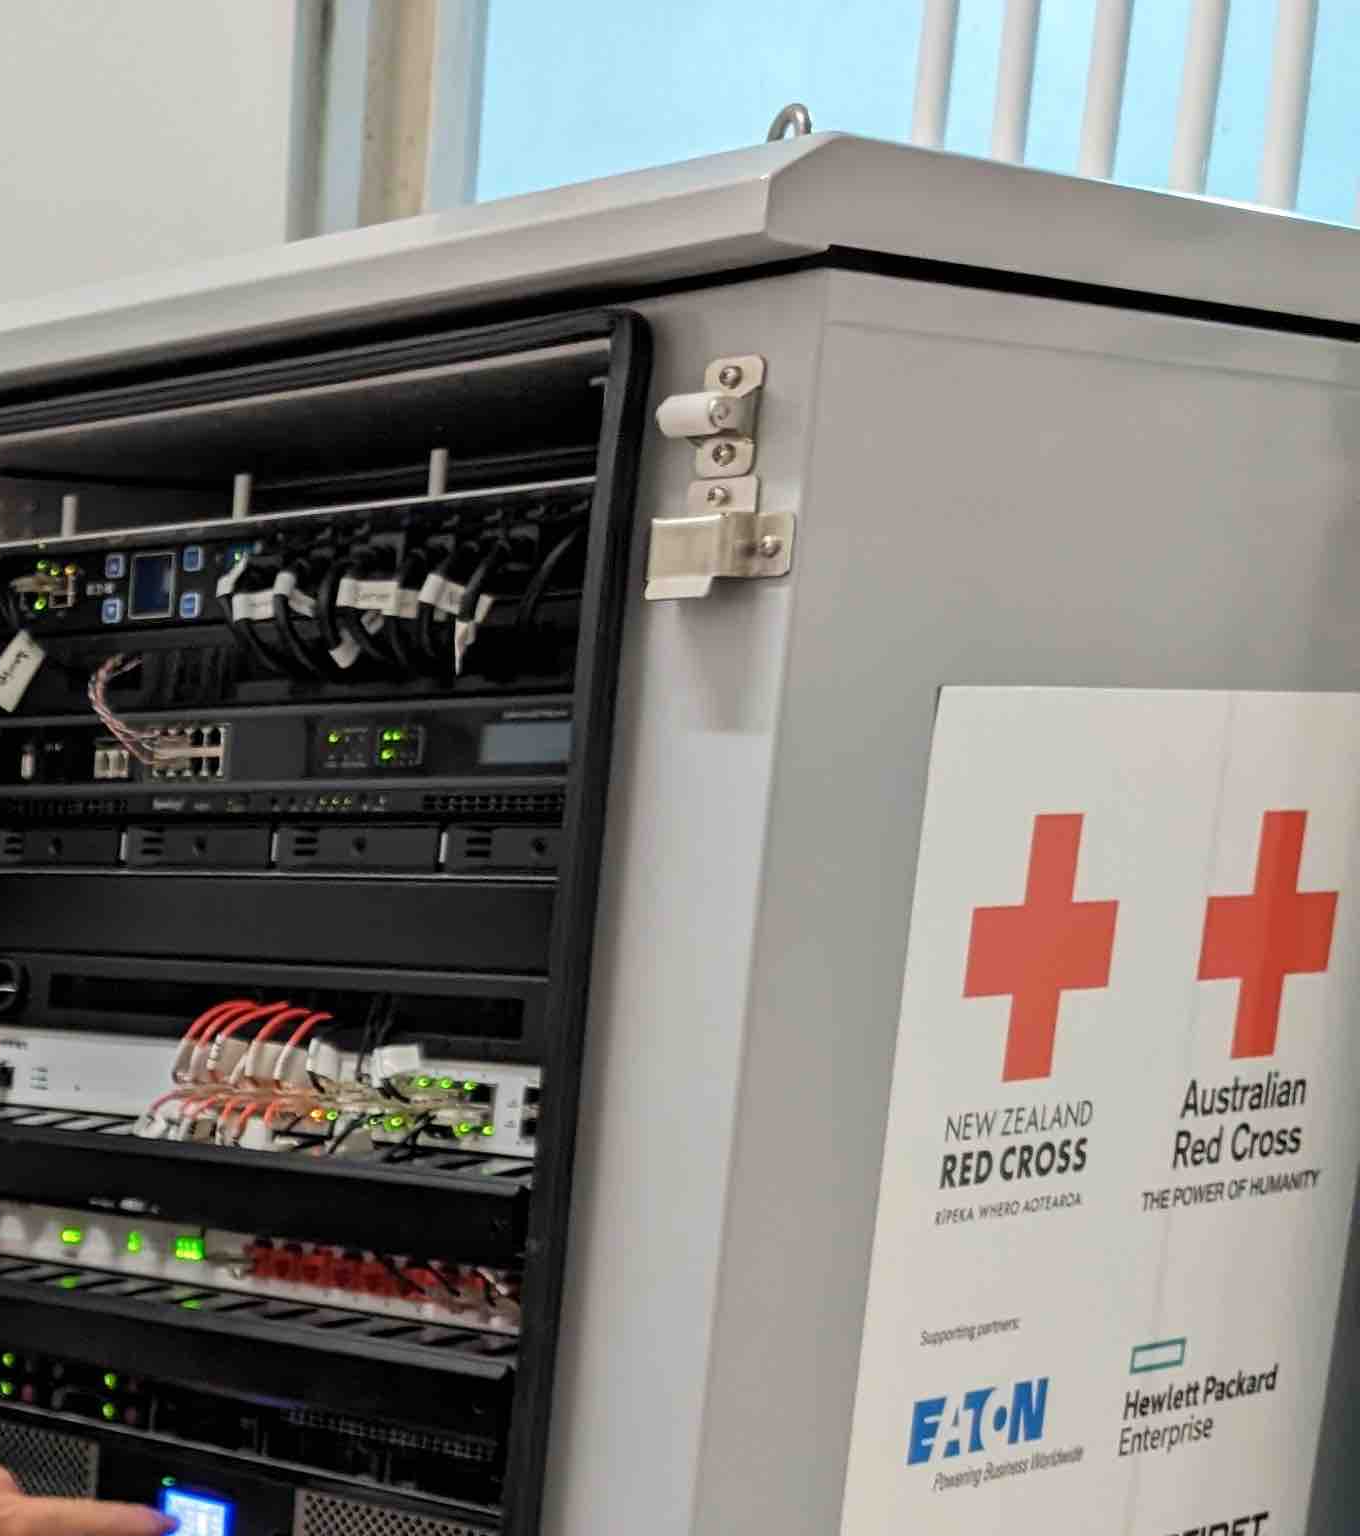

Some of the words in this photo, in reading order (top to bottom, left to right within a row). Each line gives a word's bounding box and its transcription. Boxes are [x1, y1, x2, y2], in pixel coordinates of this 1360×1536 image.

[1180, 1070, 1307, 1119] Australian
[945, 1109, 997, 1142] NEW
[1001, 1100, 1094, 1136] ZEALAND
[939, 1150, 994, 1189] RED
[999, 1137, 1088, 1181] CROSS
[1172, 1124, 1224, 1170] Red
[1231, 1122, 1302, 1162] Cross
[1142, 1188, 1170, 1211] THE
[1172, 1181, 1225, 1207] POWER
[1228, 1179, 1248, 1200] OF
[1250, 1169, 1321, 1197] HUMANITY
[920, 1324, 977, 1347] Supporting
[1123, 1380, 1200, 1420] Hewlett
[1203, 1363, 1279, 1405] Packard
[906, 1376, 1049, 1466] EATON
[1118, 1413, 1213, 1457] Enterprise
[983, 1458, 1029, 1482] Business
